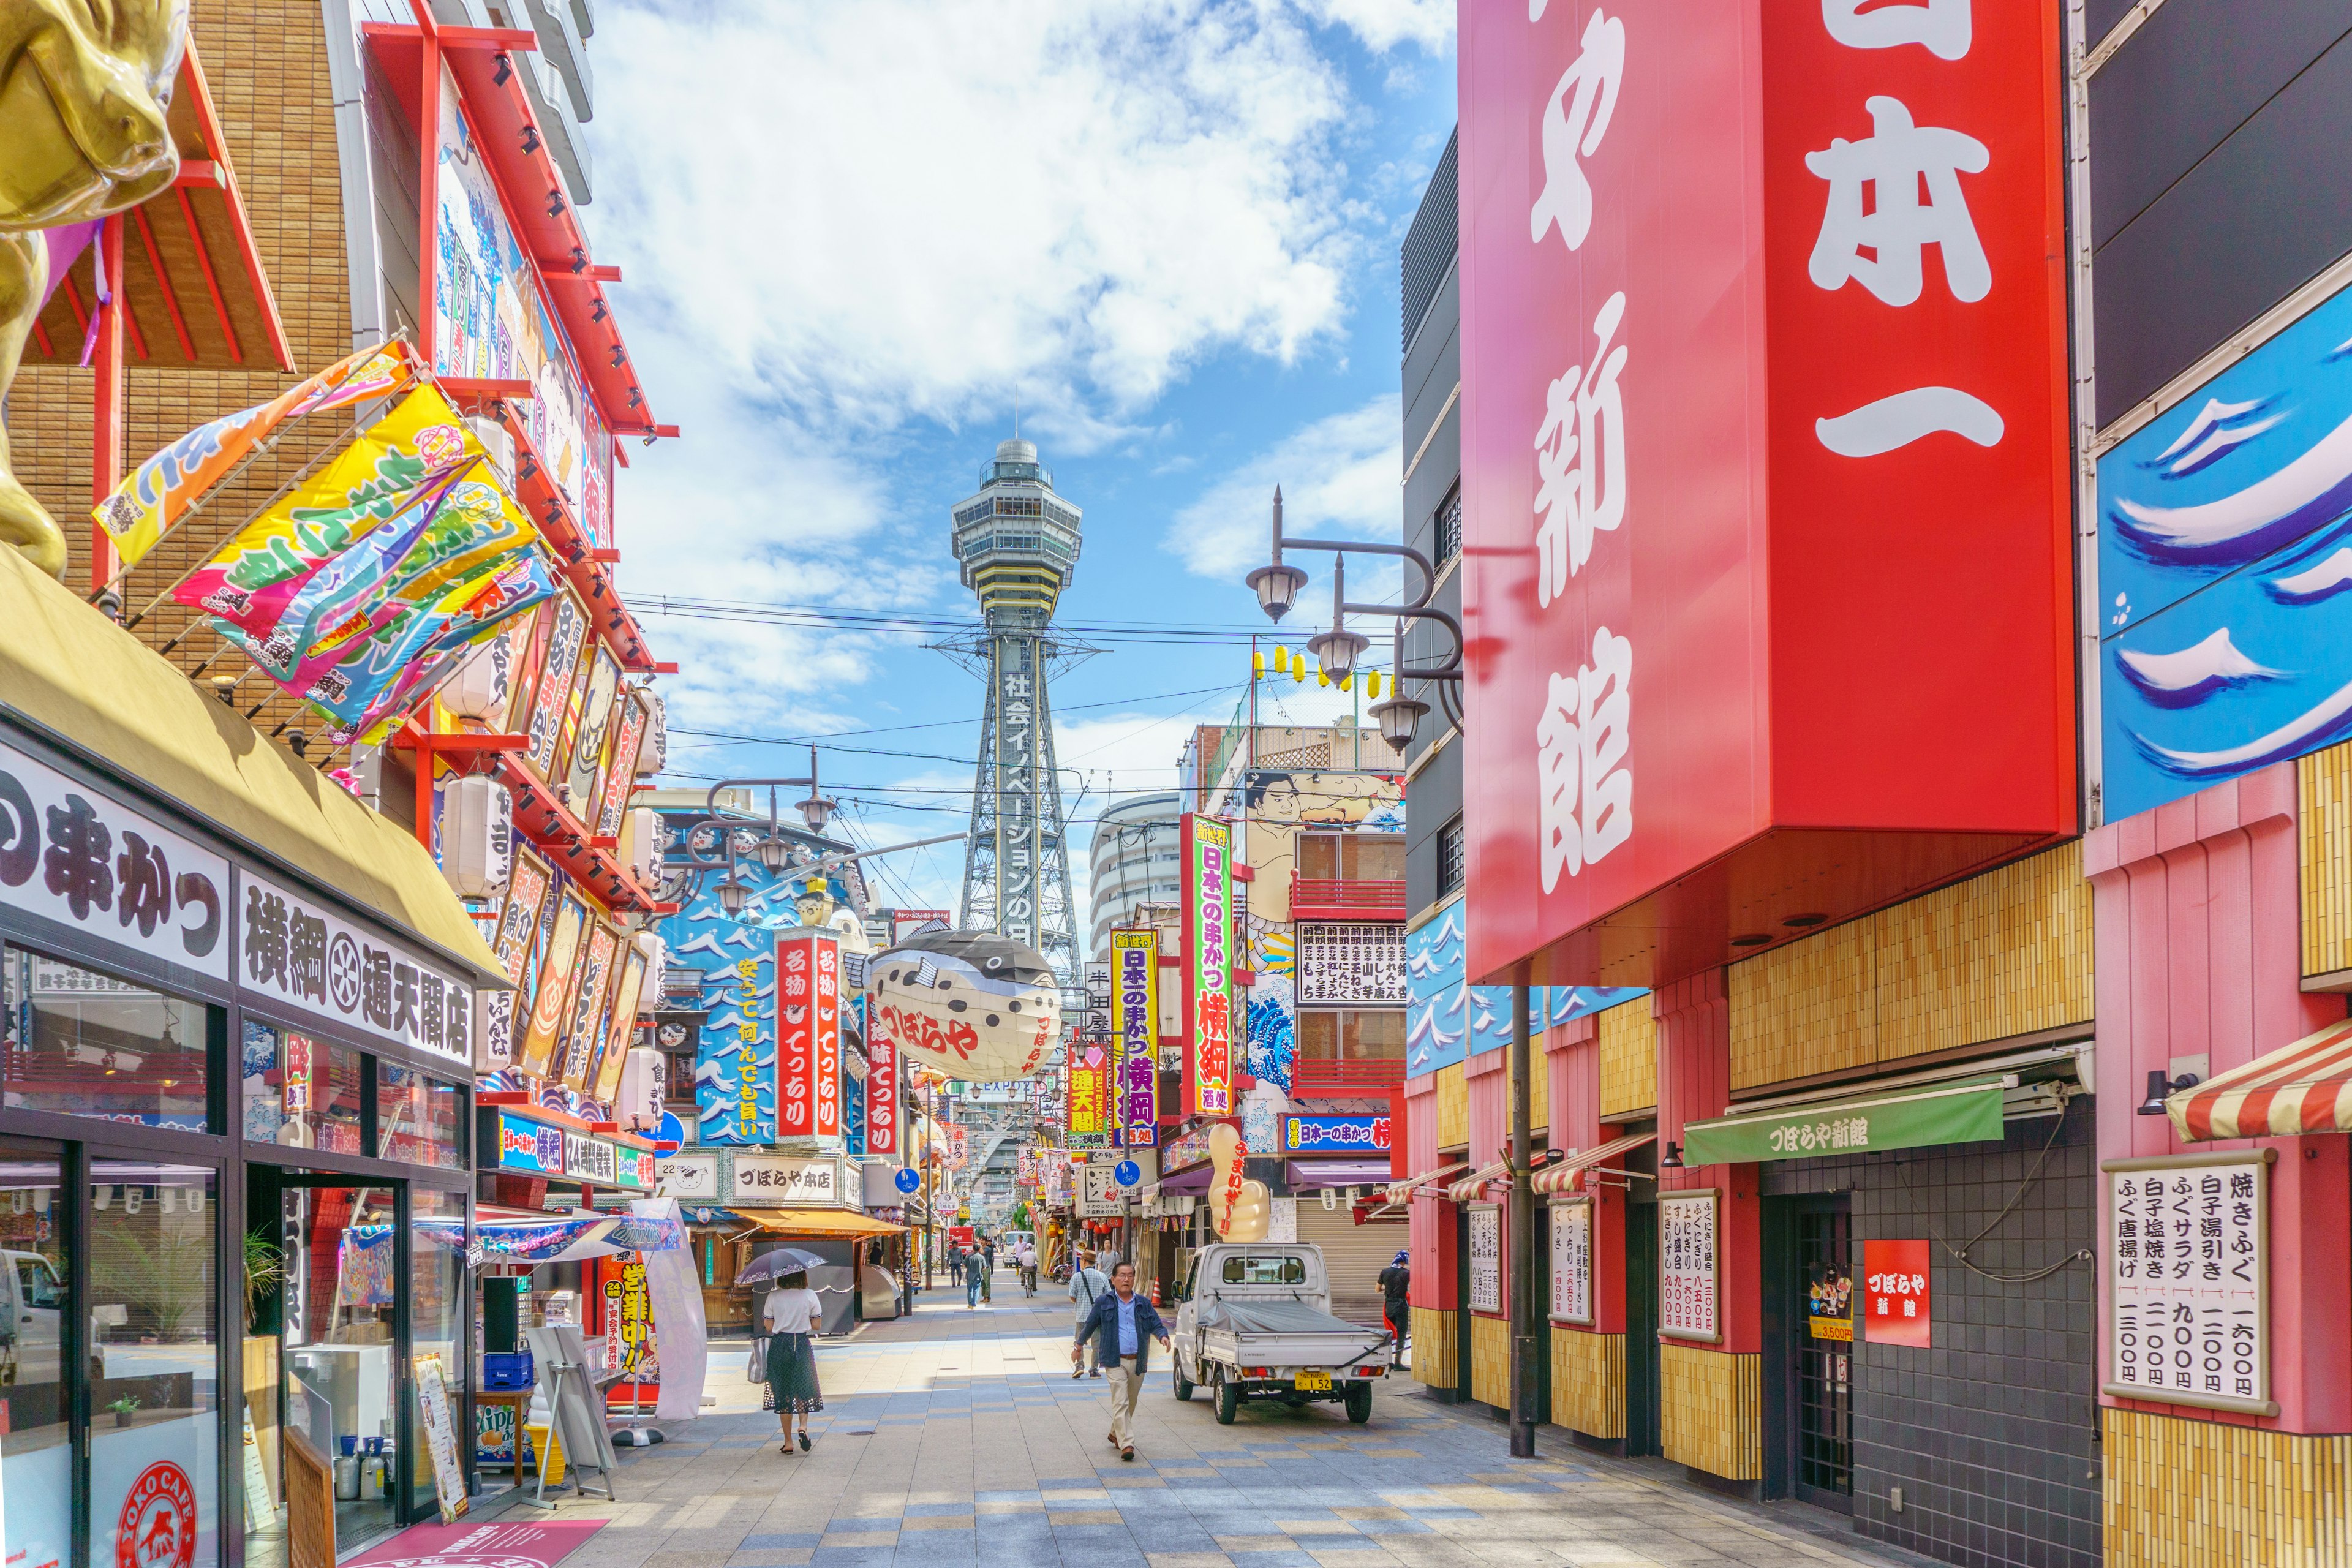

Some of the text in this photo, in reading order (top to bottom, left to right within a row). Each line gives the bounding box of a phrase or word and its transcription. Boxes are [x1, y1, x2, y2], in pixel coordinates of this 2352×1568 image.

[1528, 0, 1633, 895] や新館
[1196, 822, 1228, 848] 新世界
[1201, 845, 1226, 990] 日本一の串かつ
[1303, 927, 1314, 945] 前頭
[1327, 927, 1337, 945] 前頭
[1339, 927, 1349, 945] 前頭
[1351, 927, 1361, 945] 前頭
[1363, 927, 1373, 945] 前頭
[1374, 927, 1385, 945] 前頭
[1115, 934, 1154, 949] 新世界
[244, 884, 328, 1008] 横綱
[361, 943, 469, 1058] 通天閣店
[1303, 962, 1314, 999] もち
[1315, 962, 1326, 999] うずら玉子
[1327, 962, 1338, 999] 紅しょうが
[1339, 962, 1350, 999] にんにく
[1351, 962, 1362, 999] 玉ねぎ
[1363, 962, 1373, 999] 山芋
[1374, 962, 1385, 999] しし唐
[1386, 962, 1396, 999] れんこん
[737, 957, 758, 1137] 安うて何んでも旨い
[785, 949, 807, 1128] 名物 てっちり
[818, 949, 836, 1128] 名物 てっちり
[880, 1004, 978, 1061] づぼらや
[1021, 1015, 1052, 1074] づぼらや
[1196, 990, 1230, 1085] 横綱
[1071, 1069, 1096, 1133] 通天閣
[1095, 1069, 1104, 1132] TSUTENKAKU
[1117, 1056, 1155, 1127] 横綱
[1202, 1088, 1228, 1109] 酒処
[503, 1126, 563, 1170] 日本一の串かつ 横綱
[1301, 1125, 1371, 1143] 日本一の串かつ
[1769, 1116, 1869, 1153] づぼらや新館
[567, 1137, 611, 1178] 24時間営業
[637, 1154, 654, 1186] 横綱
[739, 1170, 831, 1191] づぼらや本店
[1664, 1204, 1672, 1270] にぎりずし
[1673, 1204, 1682, 1270] すし盛合
[1694, 1202, 1702, 1270] ふぐにぎり
[2144, 1177, 2165, 1280] 白子塩焼き
[2201, 1174, 2223, 1281] 白子湯引き
[2230, 1172, 2255, 1283] 焼きふぐ
[469, 1251, 483, 1264] OPEN
[1868, 1273, 1925, 1295] づぼらや
[2117, 1178, 2138, 1382] ふぐ唐揚げ 一三〇〇円
[2171, 1175, 2195, 1389] ふぐサラダ 九〇〇円
[1877, 1297, 1917, 1317] 新 館
[1822, 1325, 1853, 1341] 3,500円
[122, 1471, 194, 1542] YOKO CAFE
